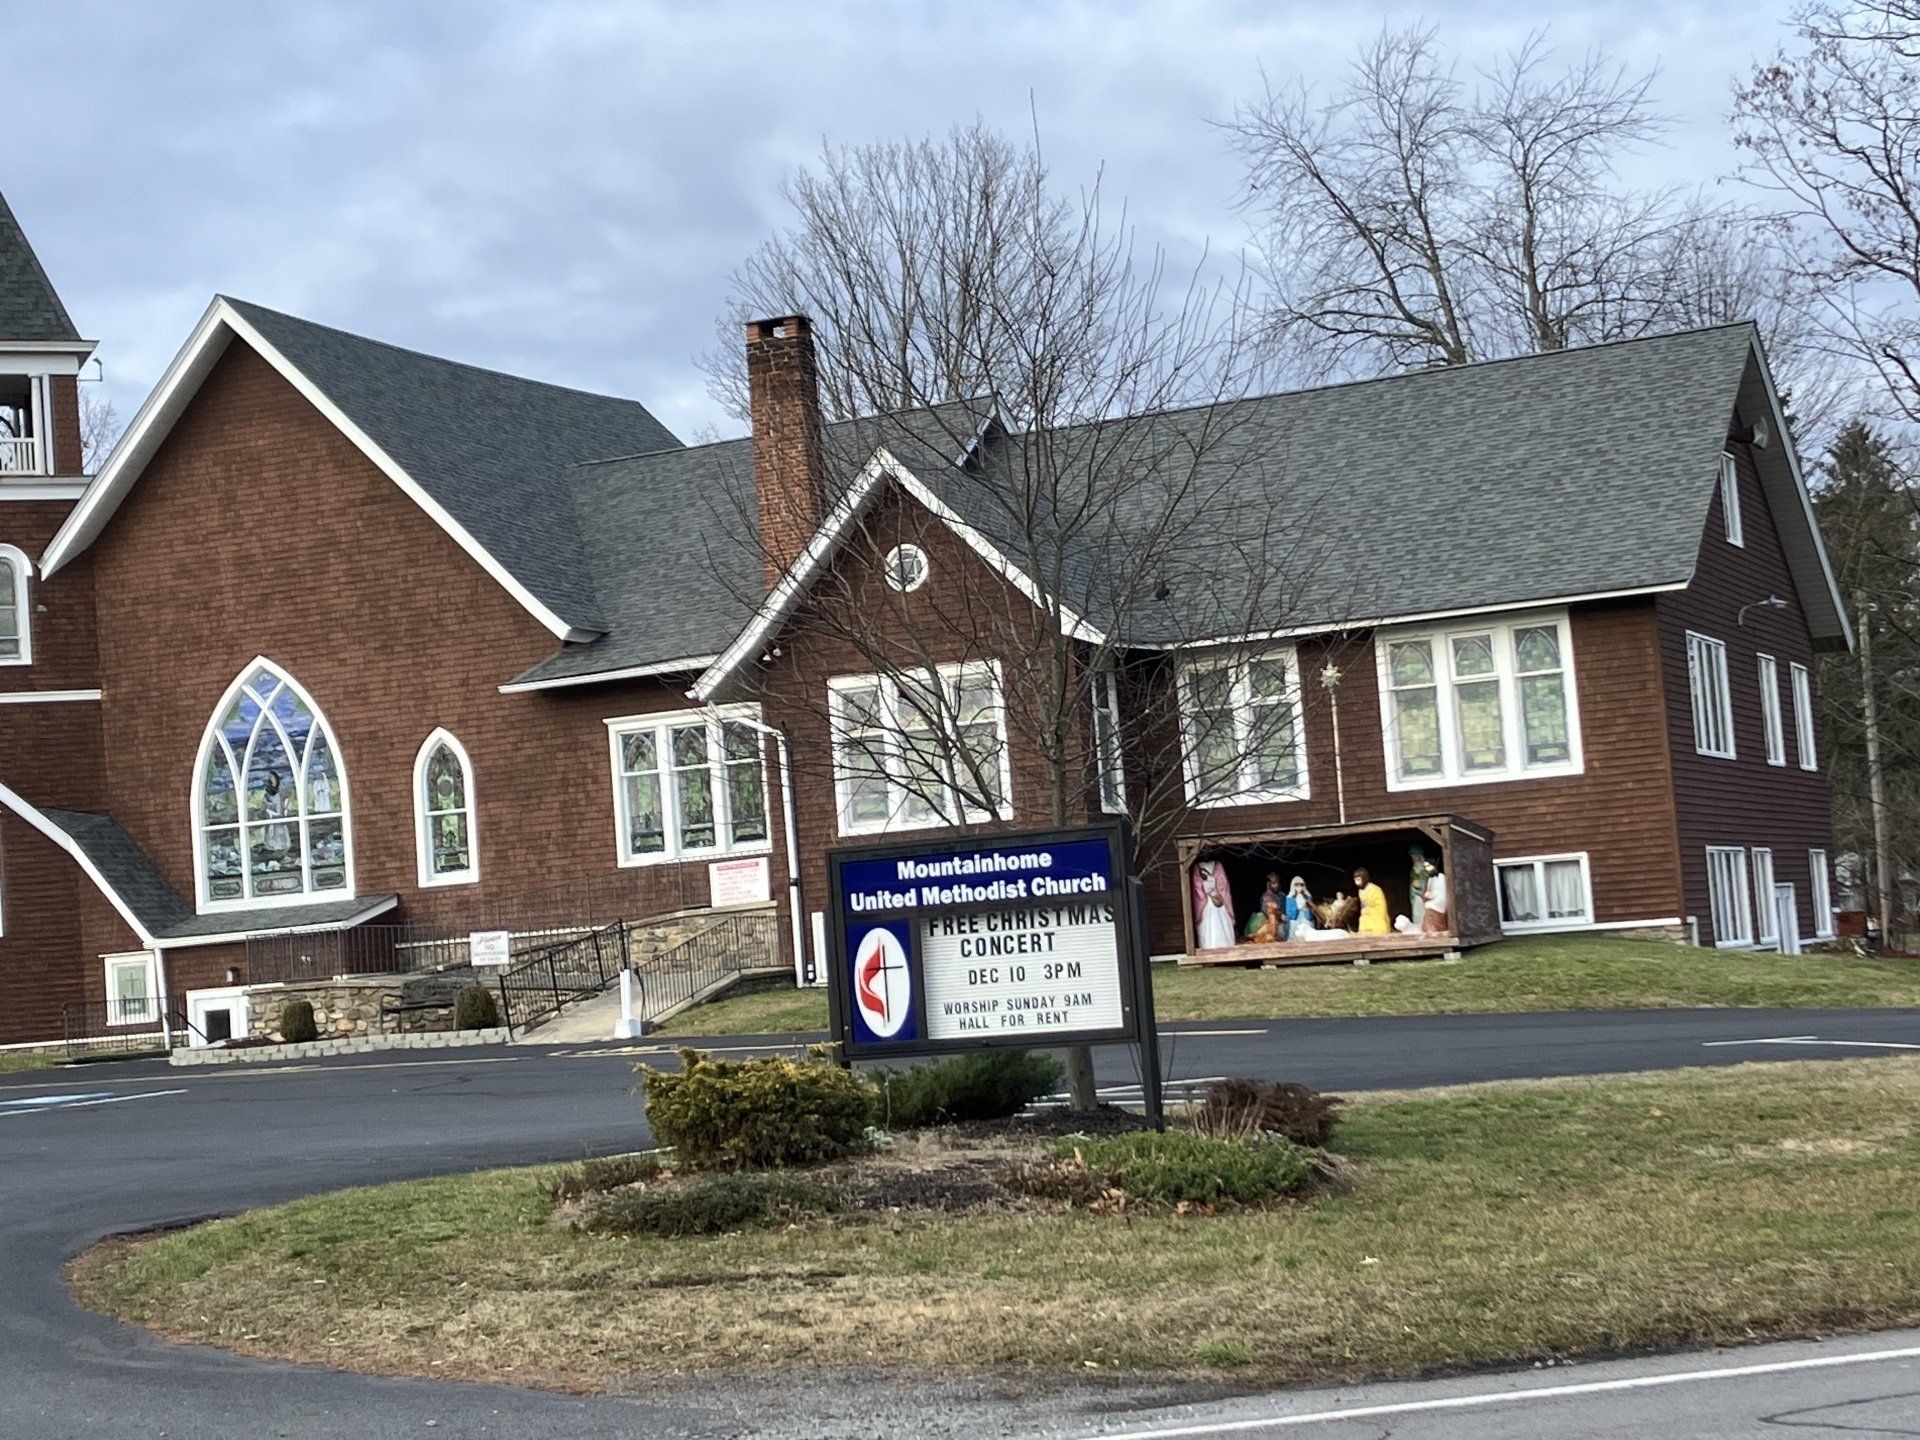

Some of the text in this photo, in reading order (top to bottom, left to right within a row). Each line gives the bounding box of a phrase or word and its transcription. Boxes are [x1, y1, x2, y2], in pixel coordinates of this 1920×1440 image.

[897, 852, 1052, 880] Mountainhome
[850, 872, 1106, 912] United Methodist Church
[929, 903, 1115, 937] FREE CHRISTMAS
[960, 931, 1056, 958] CONCERT
[968, 961, 1082, 986] DEC 10 3PM
[943, 993, 1093, 1015] WORSHIP SUNDAY 9AM
[959, 1010, 1069, 1030] HALL FOR RENT
